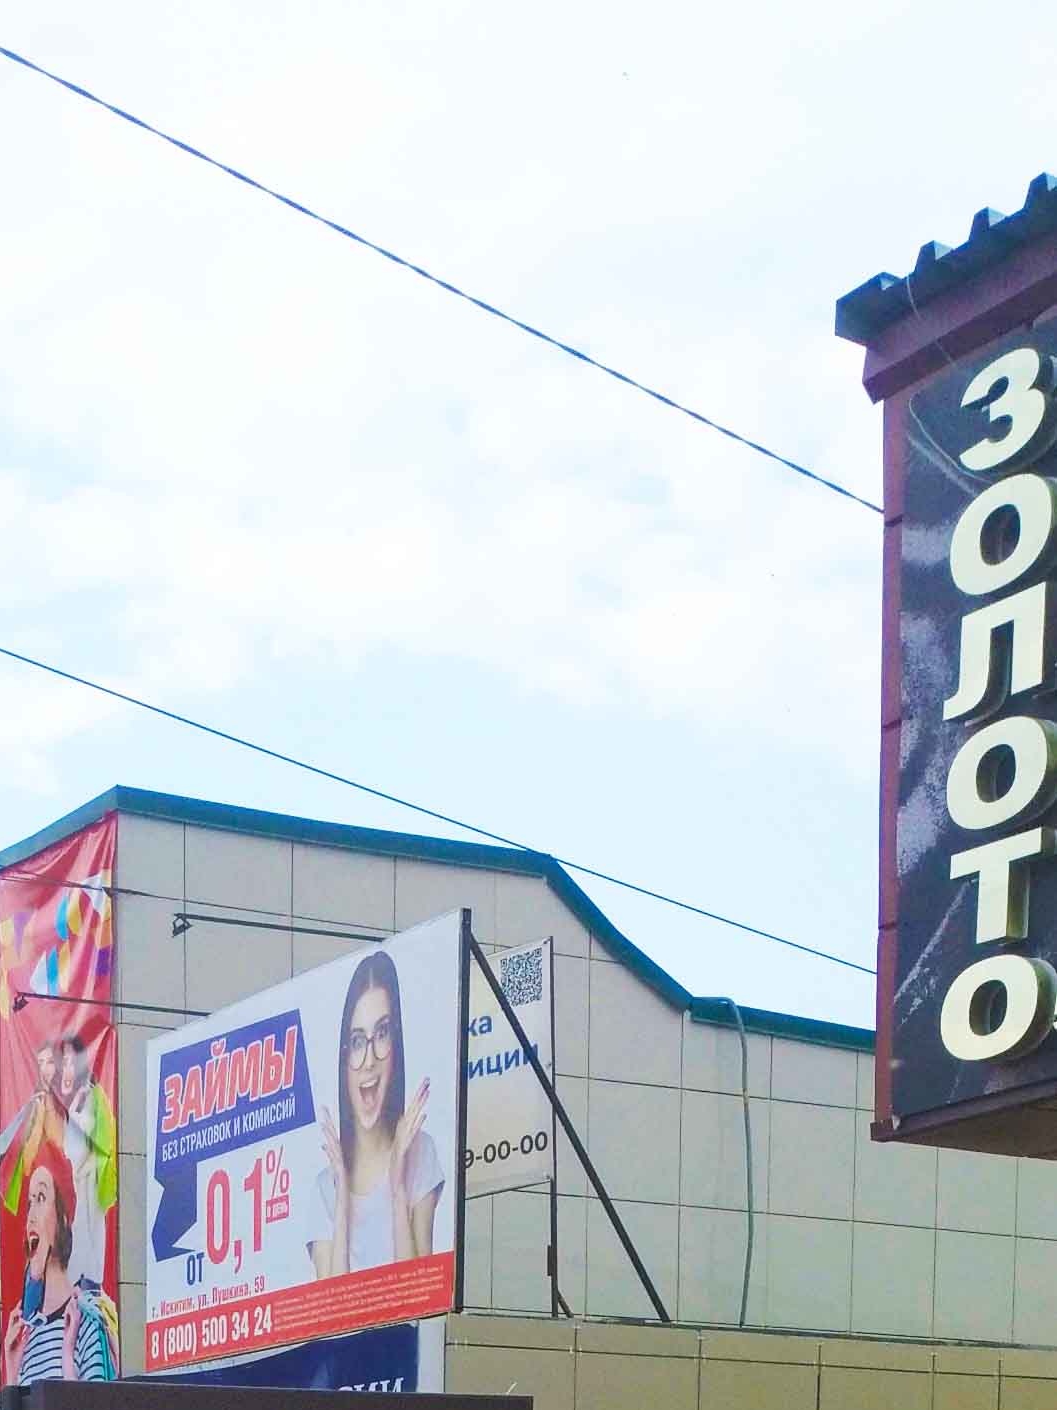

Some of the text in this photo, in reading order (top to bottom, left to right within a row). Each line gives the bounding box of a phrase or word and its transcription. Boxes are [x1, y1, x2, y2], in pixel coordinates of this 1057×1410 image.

[940, 347, 1053, 1061] ЗОЛОТО
[161, 1025, 298, 1133] ЗАЙМЫ
[162, 1094, 296, 1162] БЕЗ СТРАХОВОК И КОМИССИЙ
[186, 1144, 290, 1286] ОТ 0,1%
[254, 1275, 265, 1293] 59
[151, 1303, 273, 1361] 8 (800) 500 34 24
